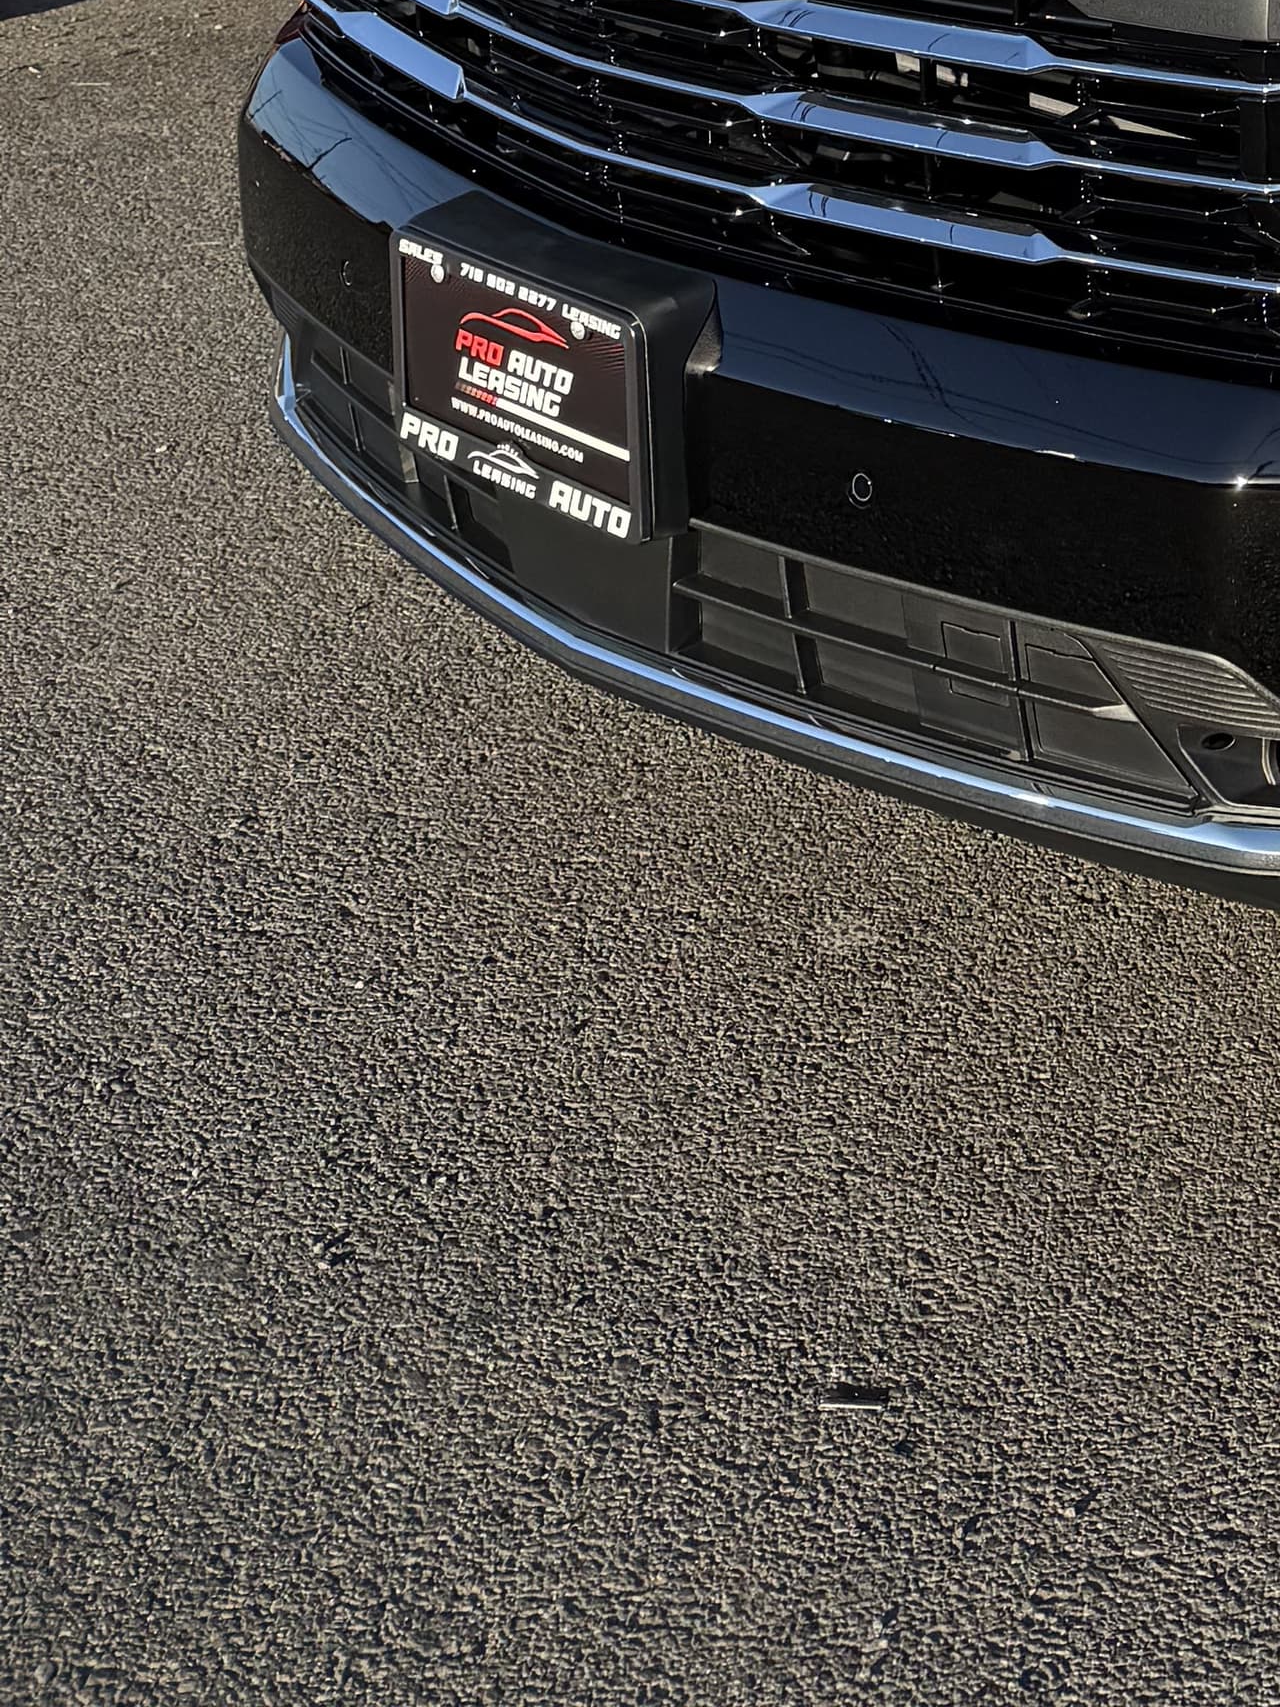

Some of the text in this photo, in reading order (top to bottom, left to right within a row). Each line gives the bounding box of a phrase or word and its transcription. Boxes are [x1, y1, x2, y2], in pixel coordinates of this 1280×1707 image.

[398, 238, 444, 267] SALES
[561, 303, 622, 340] LEASING
[455, 328, 574, 396] PRO AUTO
[458, 356, 562, 418] LEASING
[450, 396, 585, 464] WWW.PROAUTOLEASING.COM
[400, 411, 632, 540] PRO LEASING AUTO
